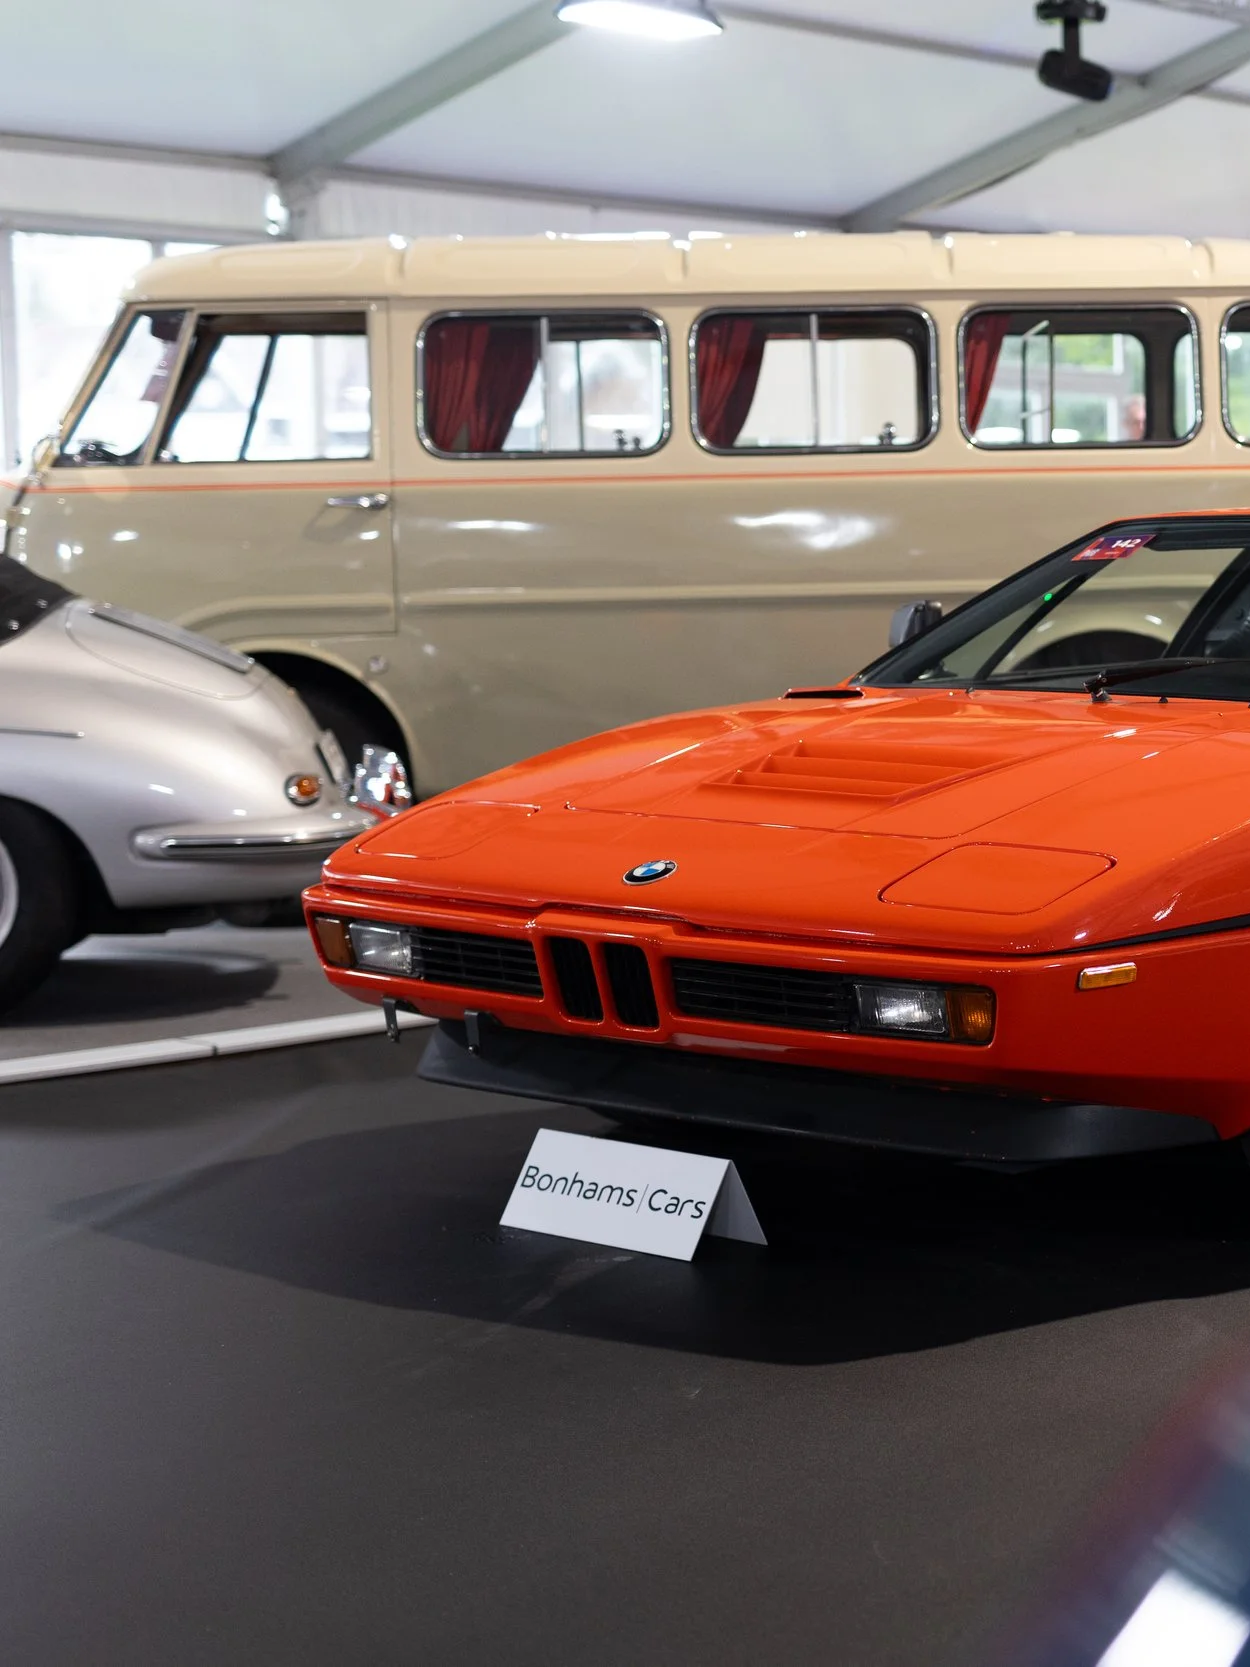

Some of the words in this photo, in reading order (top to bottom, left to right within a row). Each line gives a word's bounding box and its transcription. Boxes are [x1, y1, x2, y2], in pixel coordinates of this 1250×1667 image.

[1111, 538, 1142, 549] 142
[519, 1164, 638, 1208] Bonhams
[647, 1188, 707, 1219] Cars
